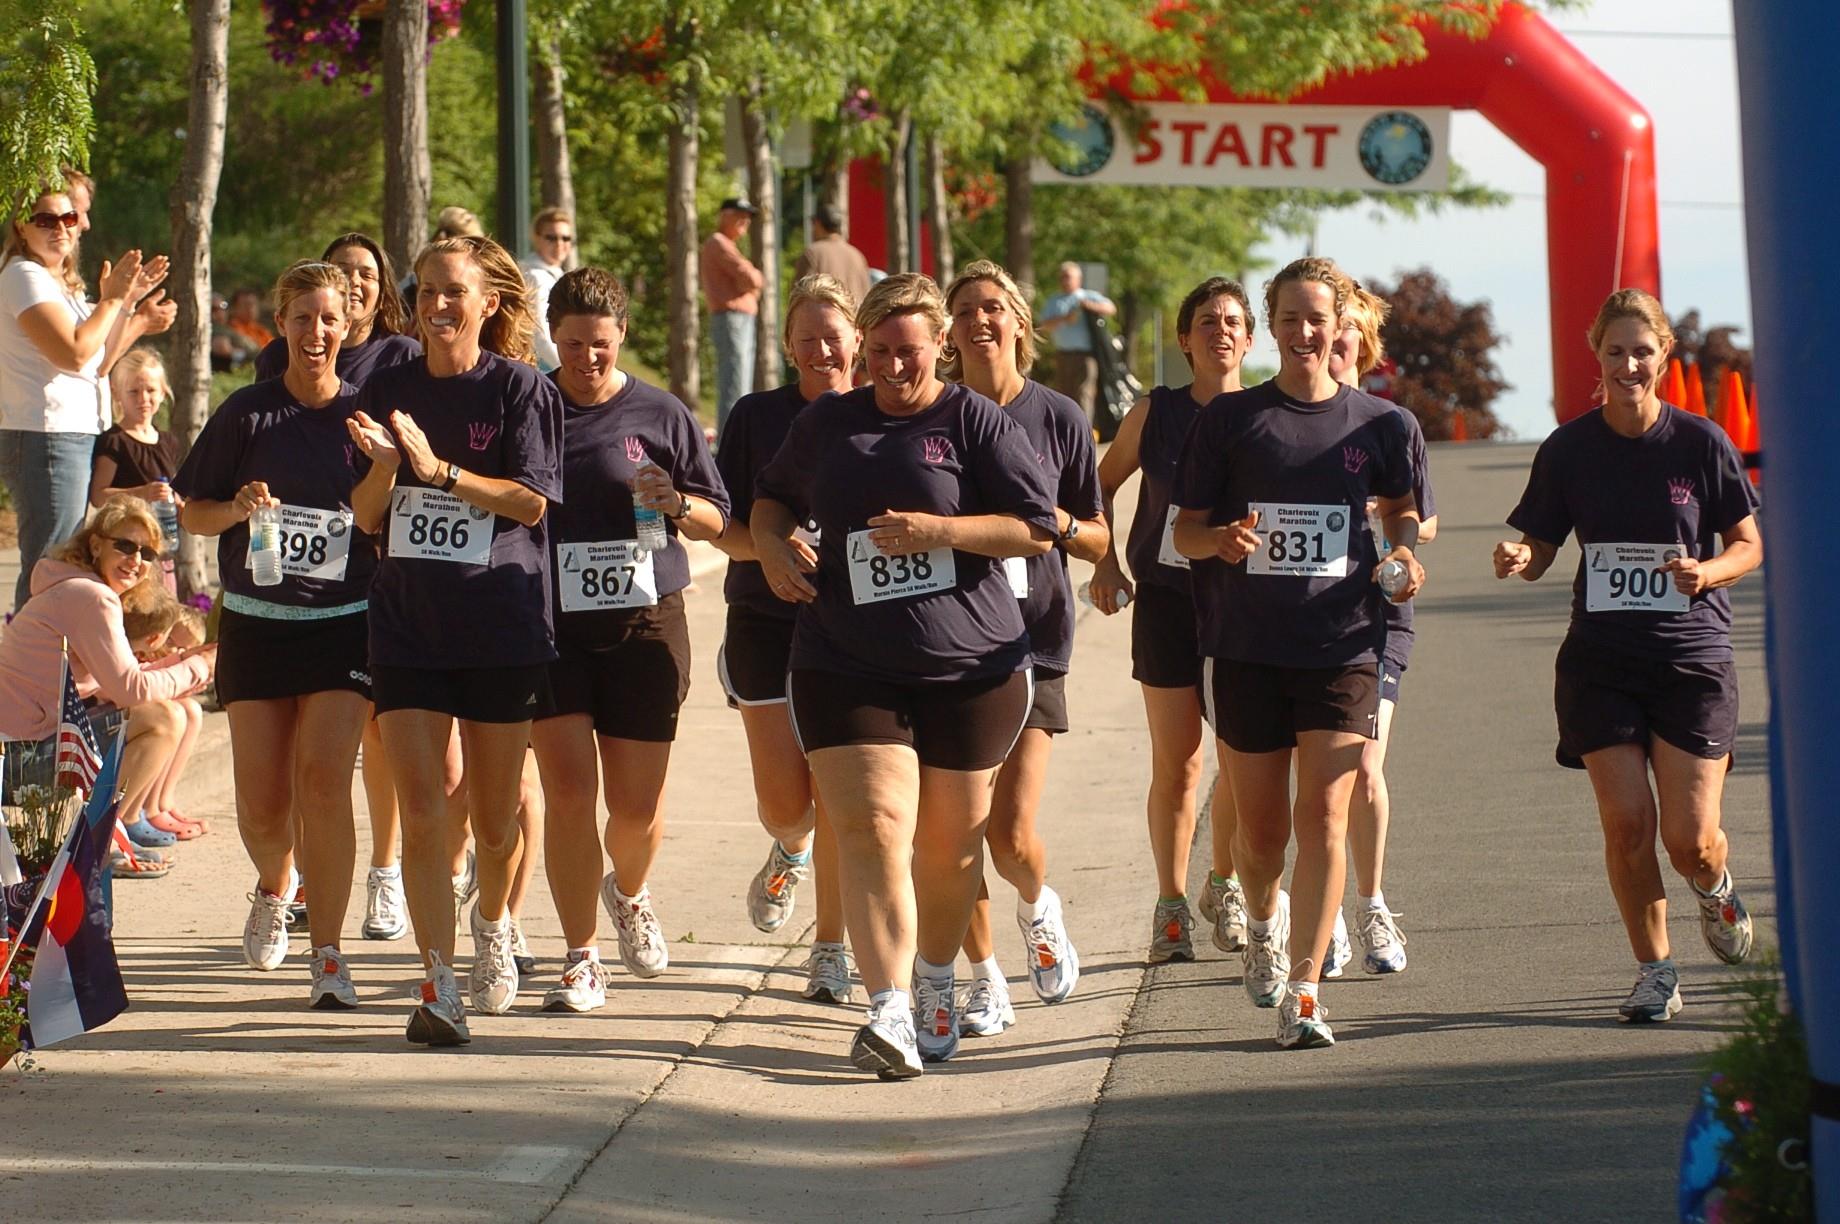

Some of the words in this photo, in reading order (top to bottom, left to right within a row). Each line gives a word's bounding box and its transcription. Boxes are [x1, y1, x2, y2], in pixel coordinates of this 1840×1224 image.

[1133, 120, 1340, 169] START
[423, 502, 461, 512] Marathon
[1277, 508, 1320, 516] Charlevoix
[282, 518, 319, 529] Marathon
[408, 514, 469, 549] 866
[1279, 517, 1317, 526] Marathon
[587, 545, 627, 553] Charlevoix
[1268, 530, 1327, 562] 831
[590, 553, 626, 562] Marathon
[870, 552, 932, 588] 838
[581, 566, 635, 598] 867
[1609, 567, 1668, 599] 900
